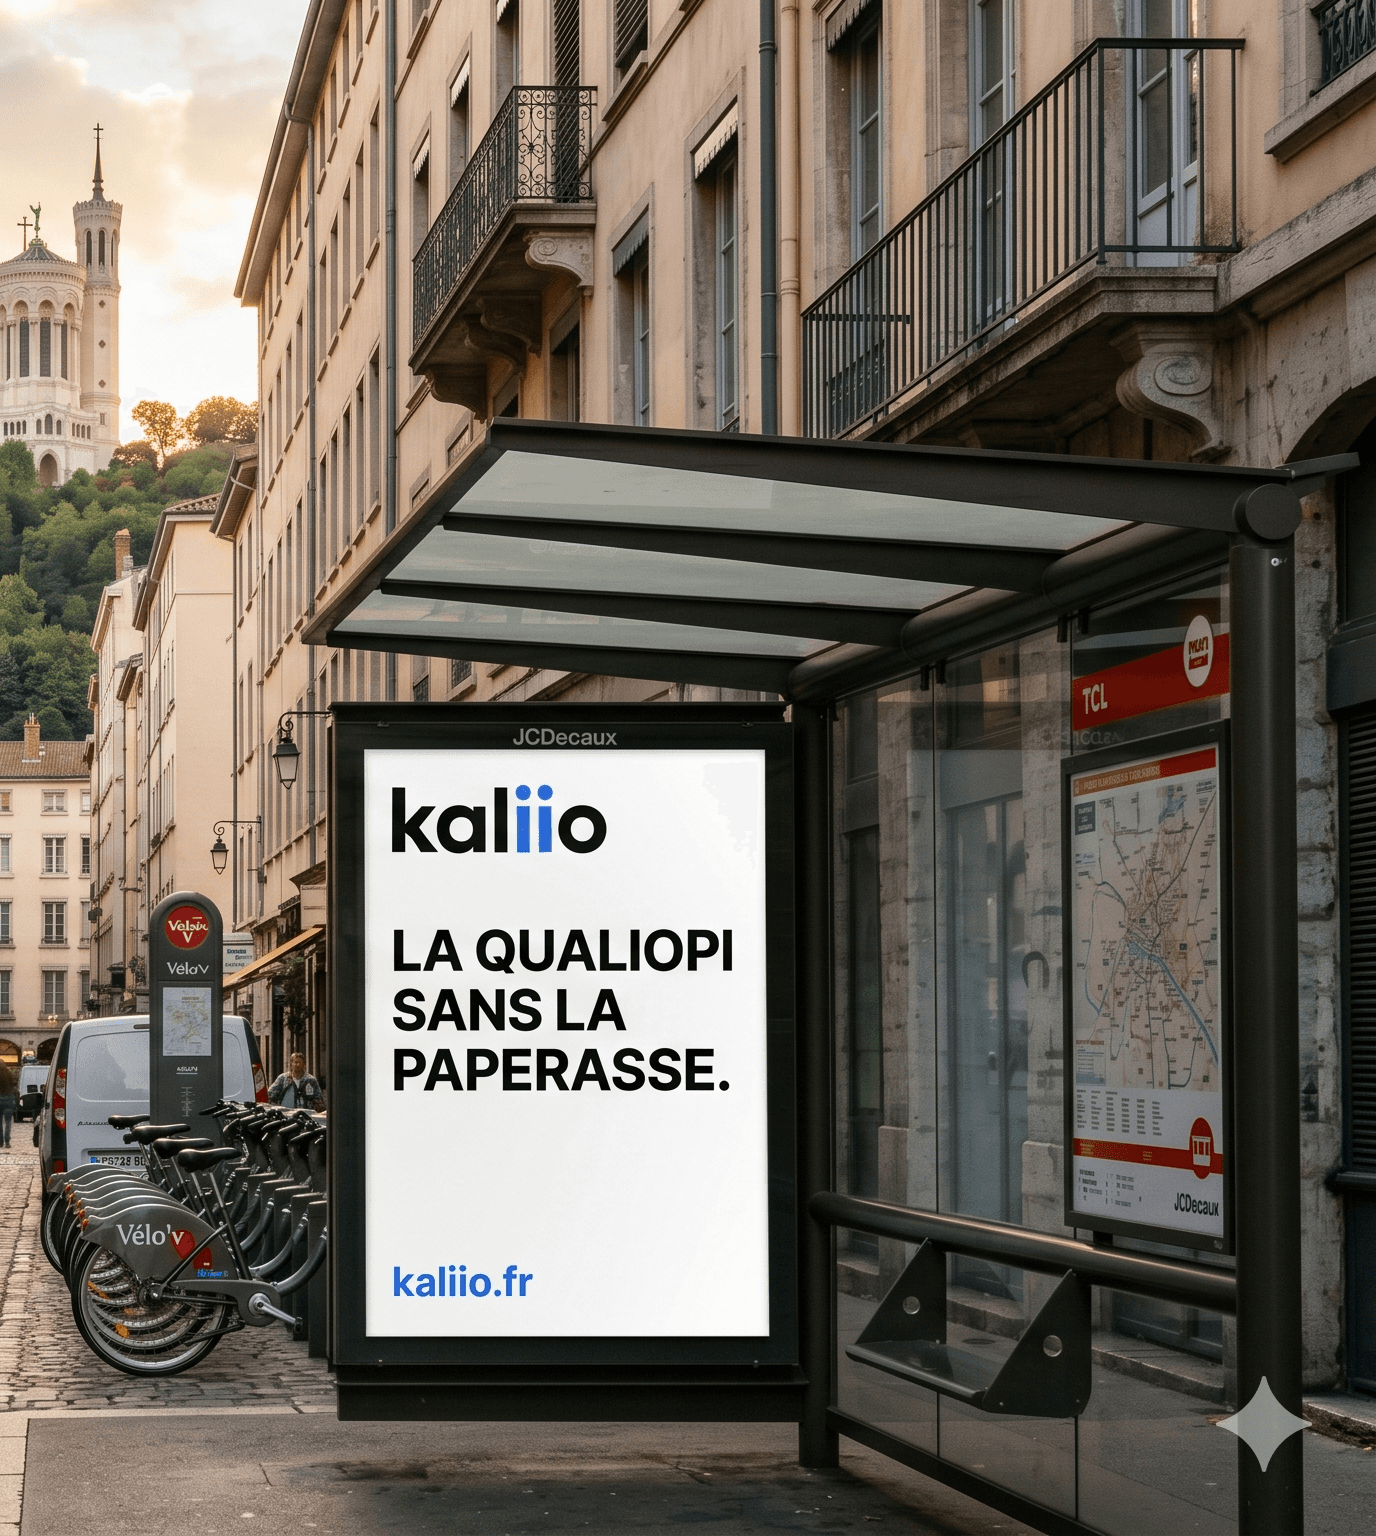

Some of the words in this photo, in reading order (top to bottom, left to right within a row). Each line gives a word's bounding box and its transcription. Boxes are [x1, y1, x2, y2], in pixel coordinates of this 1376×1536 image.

[1082, 683, 1109, 715] TCL
[512, 727, 617, 746] JCDecaux
[391, 784, 608, 855] kaliio
[393, 928, 464, 973] LA
[475, 928, 733, 975] QUALIOPI
[392, 987, 543, 1032] SANS
[556, 987, 627, 1032] LA
[393, 1047, 730, 1092] PAPERASSE.
[1174, 1192, 1220, 1217] JCDecaux
[115, 1223, 185, 1246] Vélo'v
[393, 1264, 534, 1298] kaliio.fr
